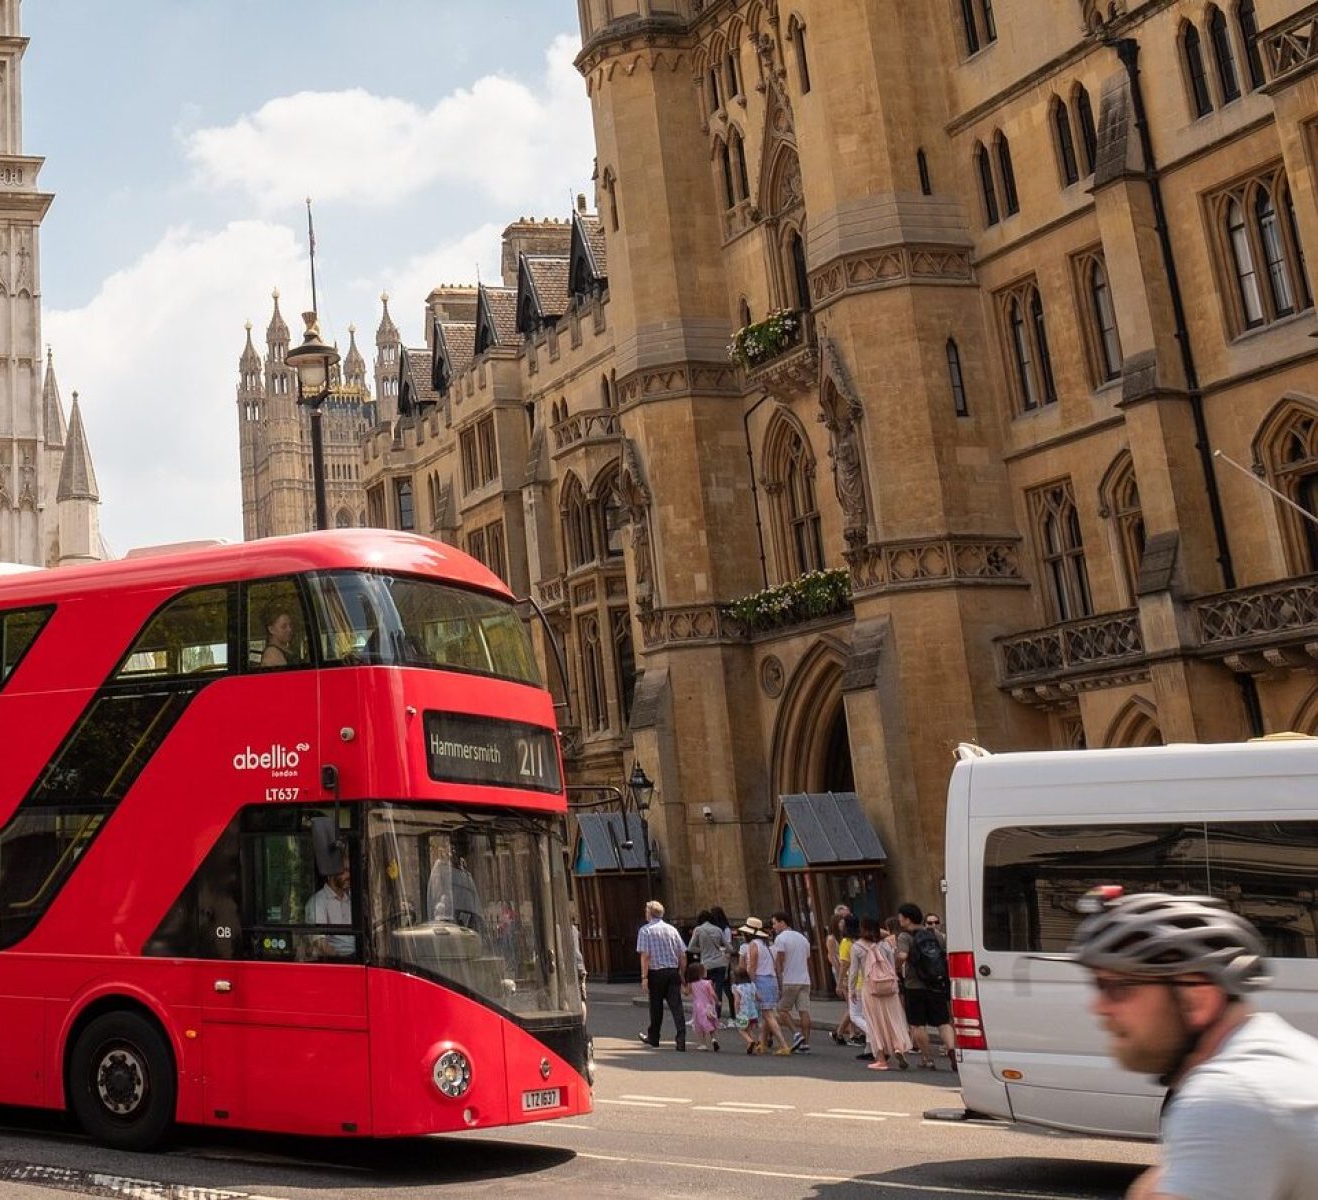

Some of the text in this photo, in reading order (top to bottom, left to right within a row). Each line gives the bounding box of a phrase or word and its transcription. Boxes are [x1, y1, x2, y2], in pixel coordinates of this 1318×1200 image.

[233, 744, 299, 770] abellio
[430, 733, 543, 778] Hammersmith 211
[265, 788, 299, 801] LT637
